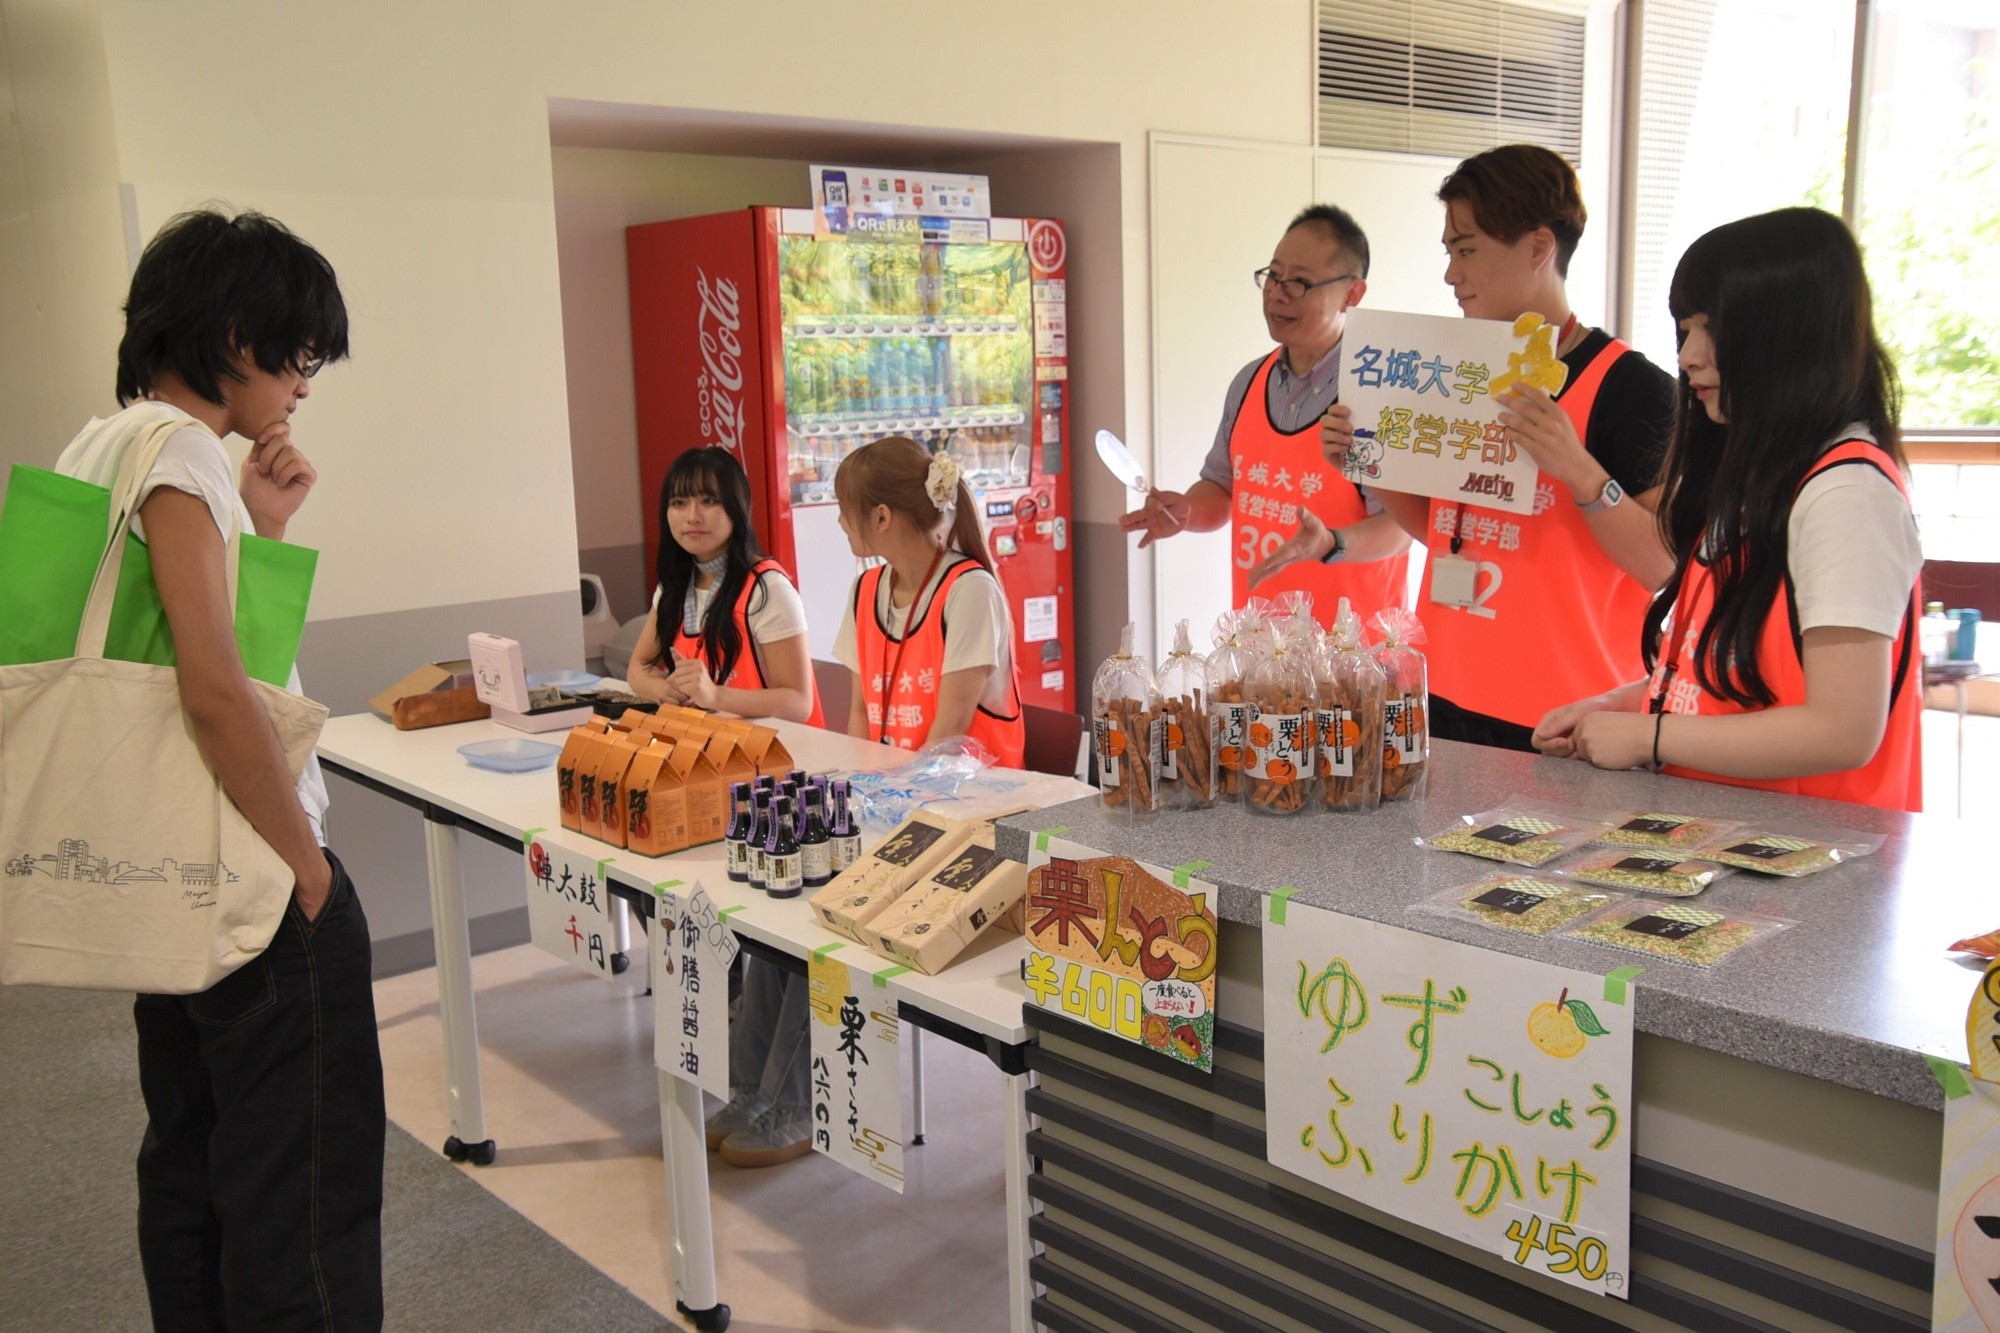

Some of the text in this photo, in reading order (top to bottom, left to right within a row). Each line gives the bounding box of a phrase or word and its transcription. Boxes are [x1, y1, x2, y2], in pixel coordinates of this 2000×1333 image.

[1351, 345, 1490, 404] 名城大学
[1376, 406, 1517, 466] 経営学部
[1459, 472, 1515, 499] Meijo
[1434, 506, 1520, 551] 経営学部
[534, 851, 601, 914] 陣太鼓
[564, 915, 605, 971] 千円
[690, 891, 736, 965] 650円
[1030, 856, 1218, 983] 栗んとう
[1025, 951, 1143, 1041] ¥600
[1149, 982, 1196, 999] 一度食べると
[1301, 1078, 1598, 1224] ふりかけ
